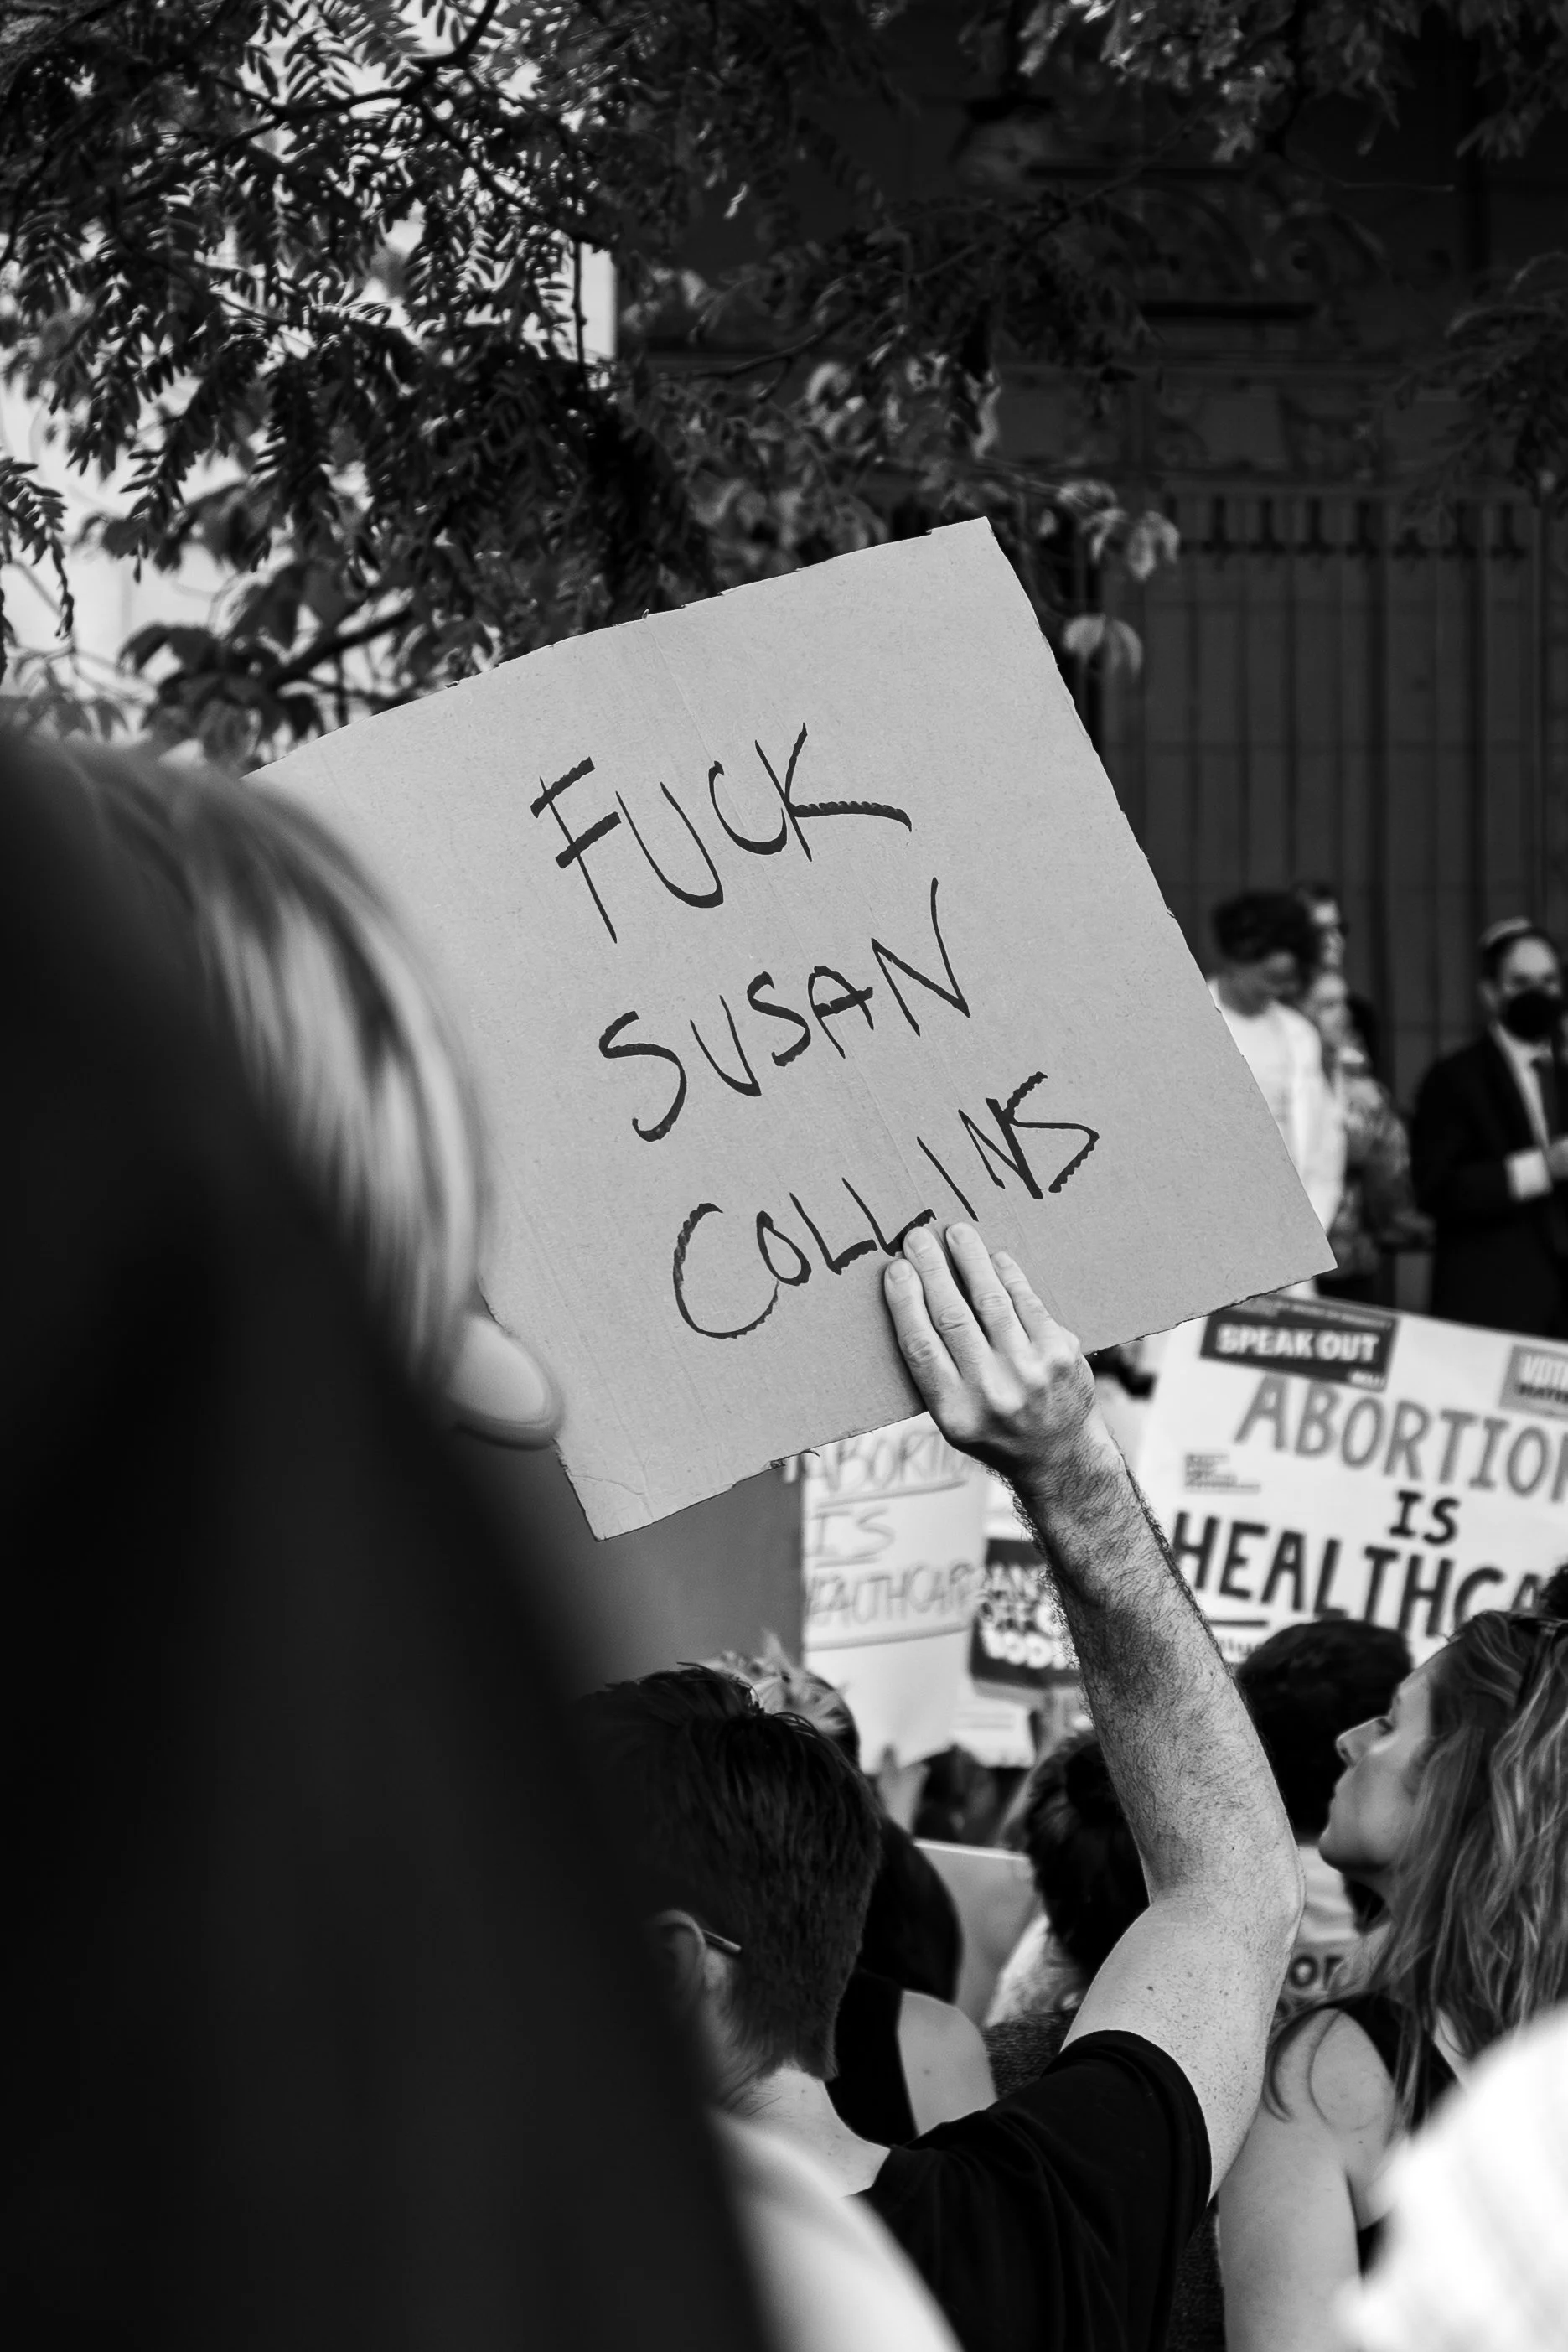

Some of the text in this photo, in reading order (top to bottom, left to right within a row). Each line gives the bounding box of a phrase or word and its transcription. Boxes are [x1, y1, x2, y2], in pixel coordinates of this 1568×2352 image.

[530, 722, 913, 944] FUCK
[598, 877, 970, 1142] SUSAN
[672, 1070, 1100, 1340] COLLINS
[1215, 1324, 1379, 1363] SPEAK OUT
[1234, 1373, 1568, 1503] ABORTIO
[810, 1505, 896, 1559] IS
[1172, 1510, 1545, 1637] HEALTHCA
[1388, 1489, 1462, 1546] IS
